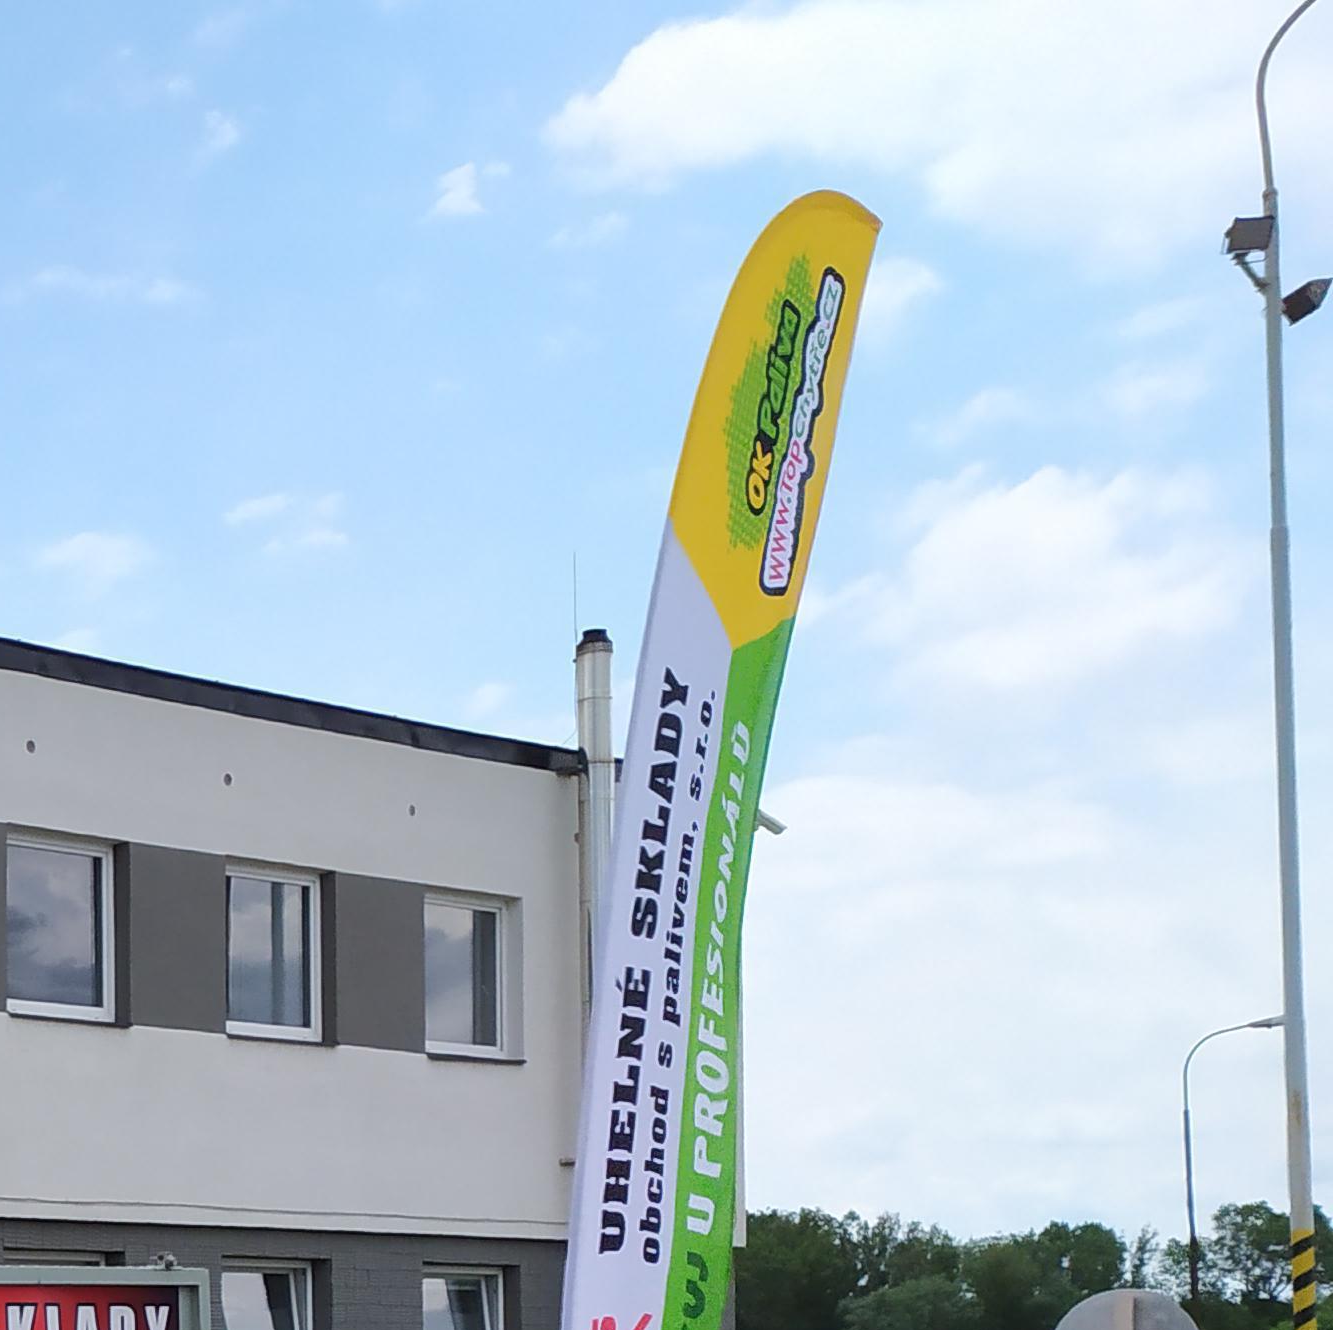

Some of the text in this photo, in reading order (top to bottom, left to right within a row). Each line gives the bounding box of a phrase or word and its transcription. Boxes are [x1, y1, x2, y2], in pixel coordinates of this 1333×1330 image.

[748, 303, 799, 510] OK Paliva
[598, 666, 690, 1255] UHELNÉ SKLADY
[639, 689, 716, 1265] obchod s palivem, s.r.o.
[687, 1193, 715, 1236] U
